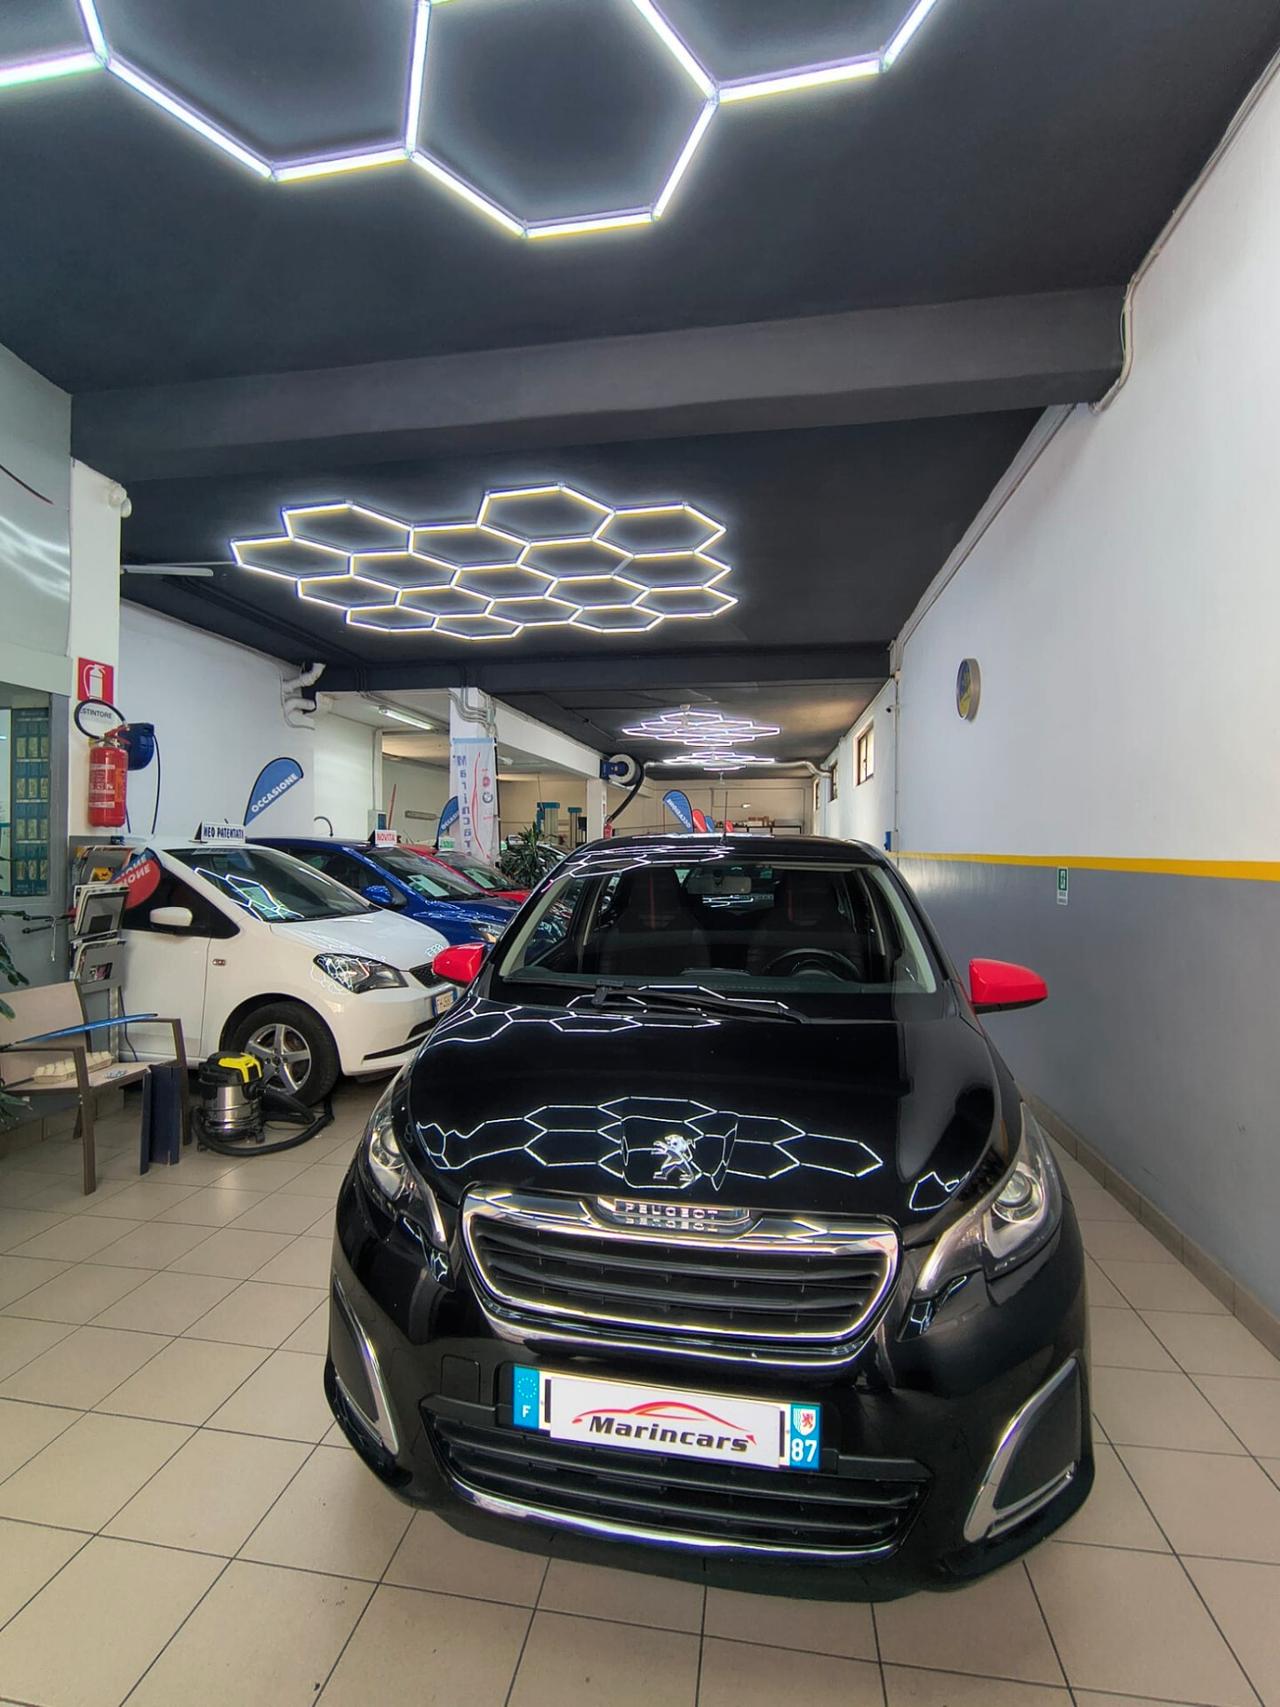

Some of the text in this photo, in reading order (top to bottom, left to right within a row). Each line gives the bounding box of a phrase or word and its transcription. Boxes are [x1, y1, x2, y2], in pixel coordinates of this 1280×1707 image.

[80, 708, 112, 719] STINTORE
[251, 773, 298, 813] OCCASIONE
[625, 1202, 718, 1220] PEUGEOT
[522, 1404, 531, 1418] F
[589, 1415, 749, 1453] Marincars
[791, 1438, 817, 1463] 87
